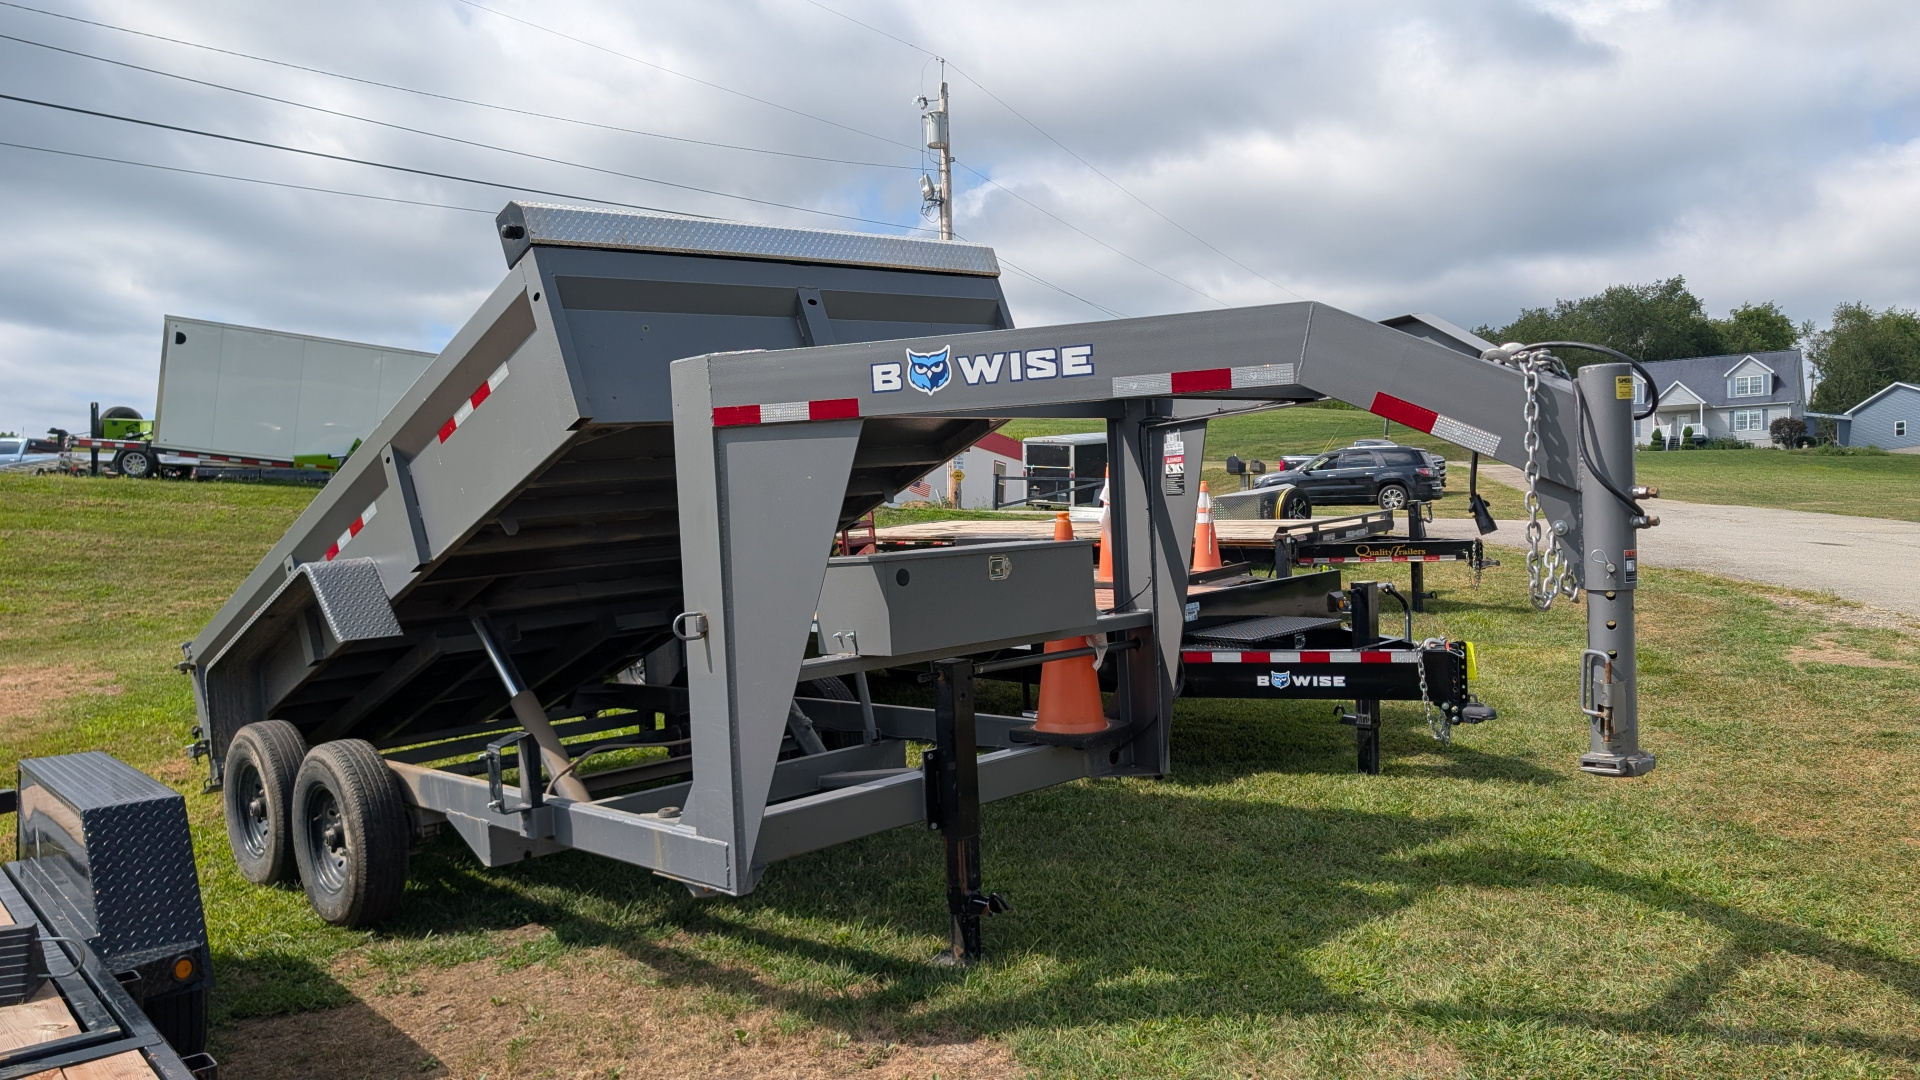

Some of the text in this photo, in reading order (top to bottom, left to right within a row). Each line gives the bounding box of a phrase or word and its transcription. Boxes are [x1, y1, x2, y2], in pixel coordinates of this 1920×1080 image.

[955, 344, 1095, 386] WISE
[1355, 544, 1426, 558] Quality Trailers
[1292, 675, 1346, 687] WISE
